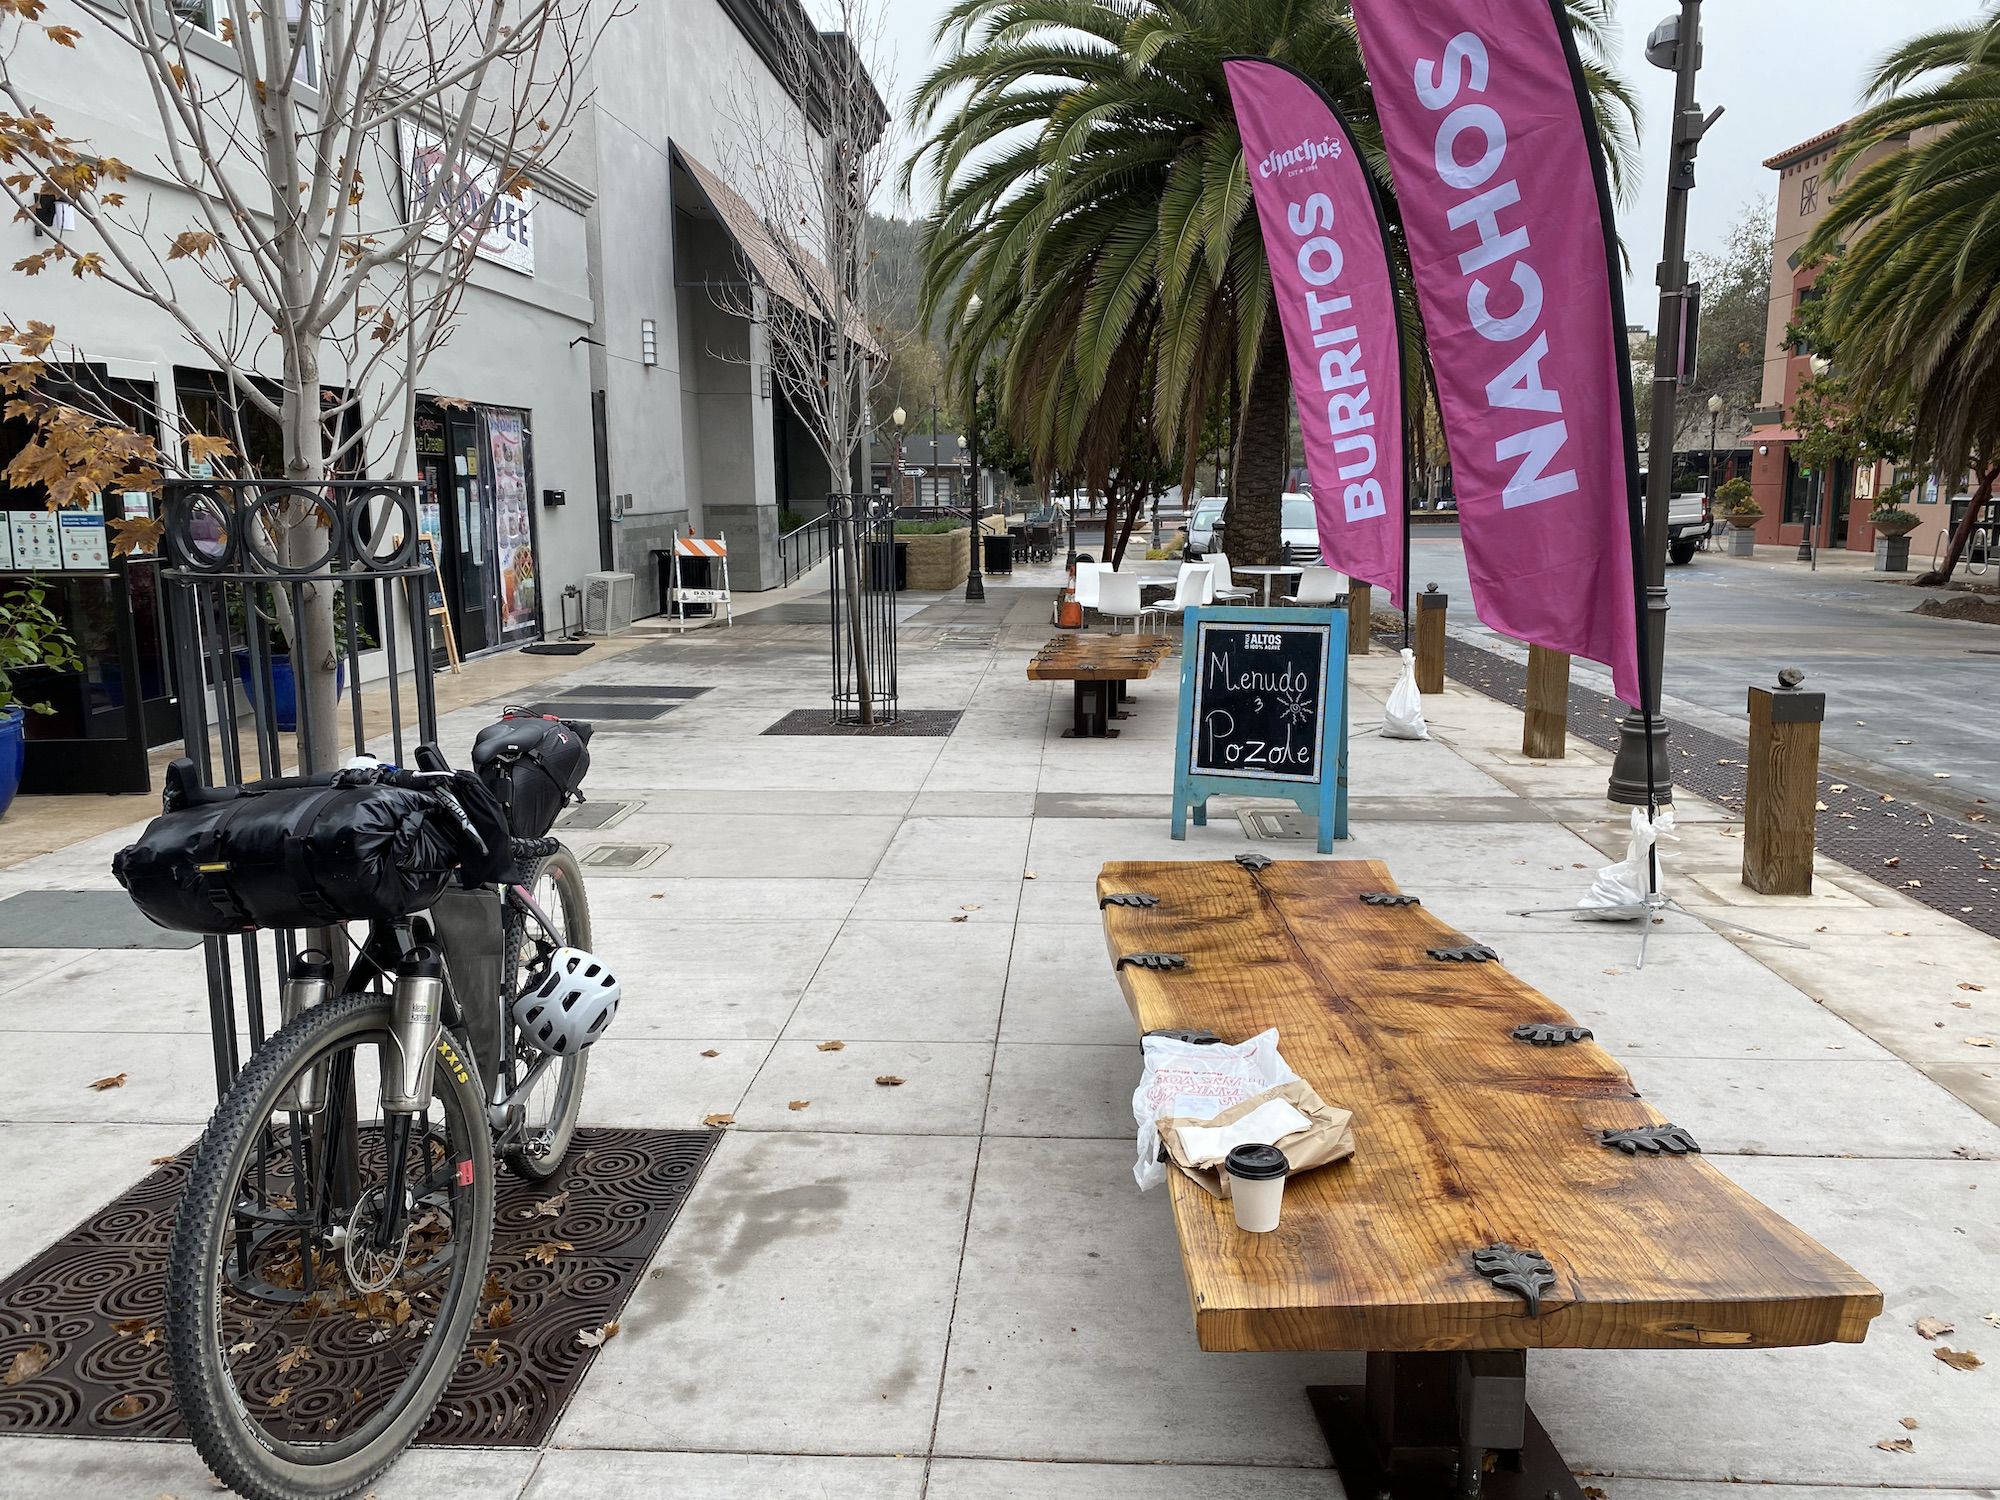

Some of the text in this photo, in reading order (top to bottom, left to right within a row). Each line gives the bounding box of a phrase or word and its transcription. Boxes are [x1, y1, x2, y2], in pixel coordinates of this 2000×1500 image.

[1414, 31, 1580, 510] NACHOS
[1287, 191, 1387, 524] BURRITOS
[1250, 633, 1281, 645] ALTOS
[1209, 651, 1307, 693] Menudo
[1204, 709, 1310, 764] Pozole
[437, 1040, 469, 1084] XXIS
